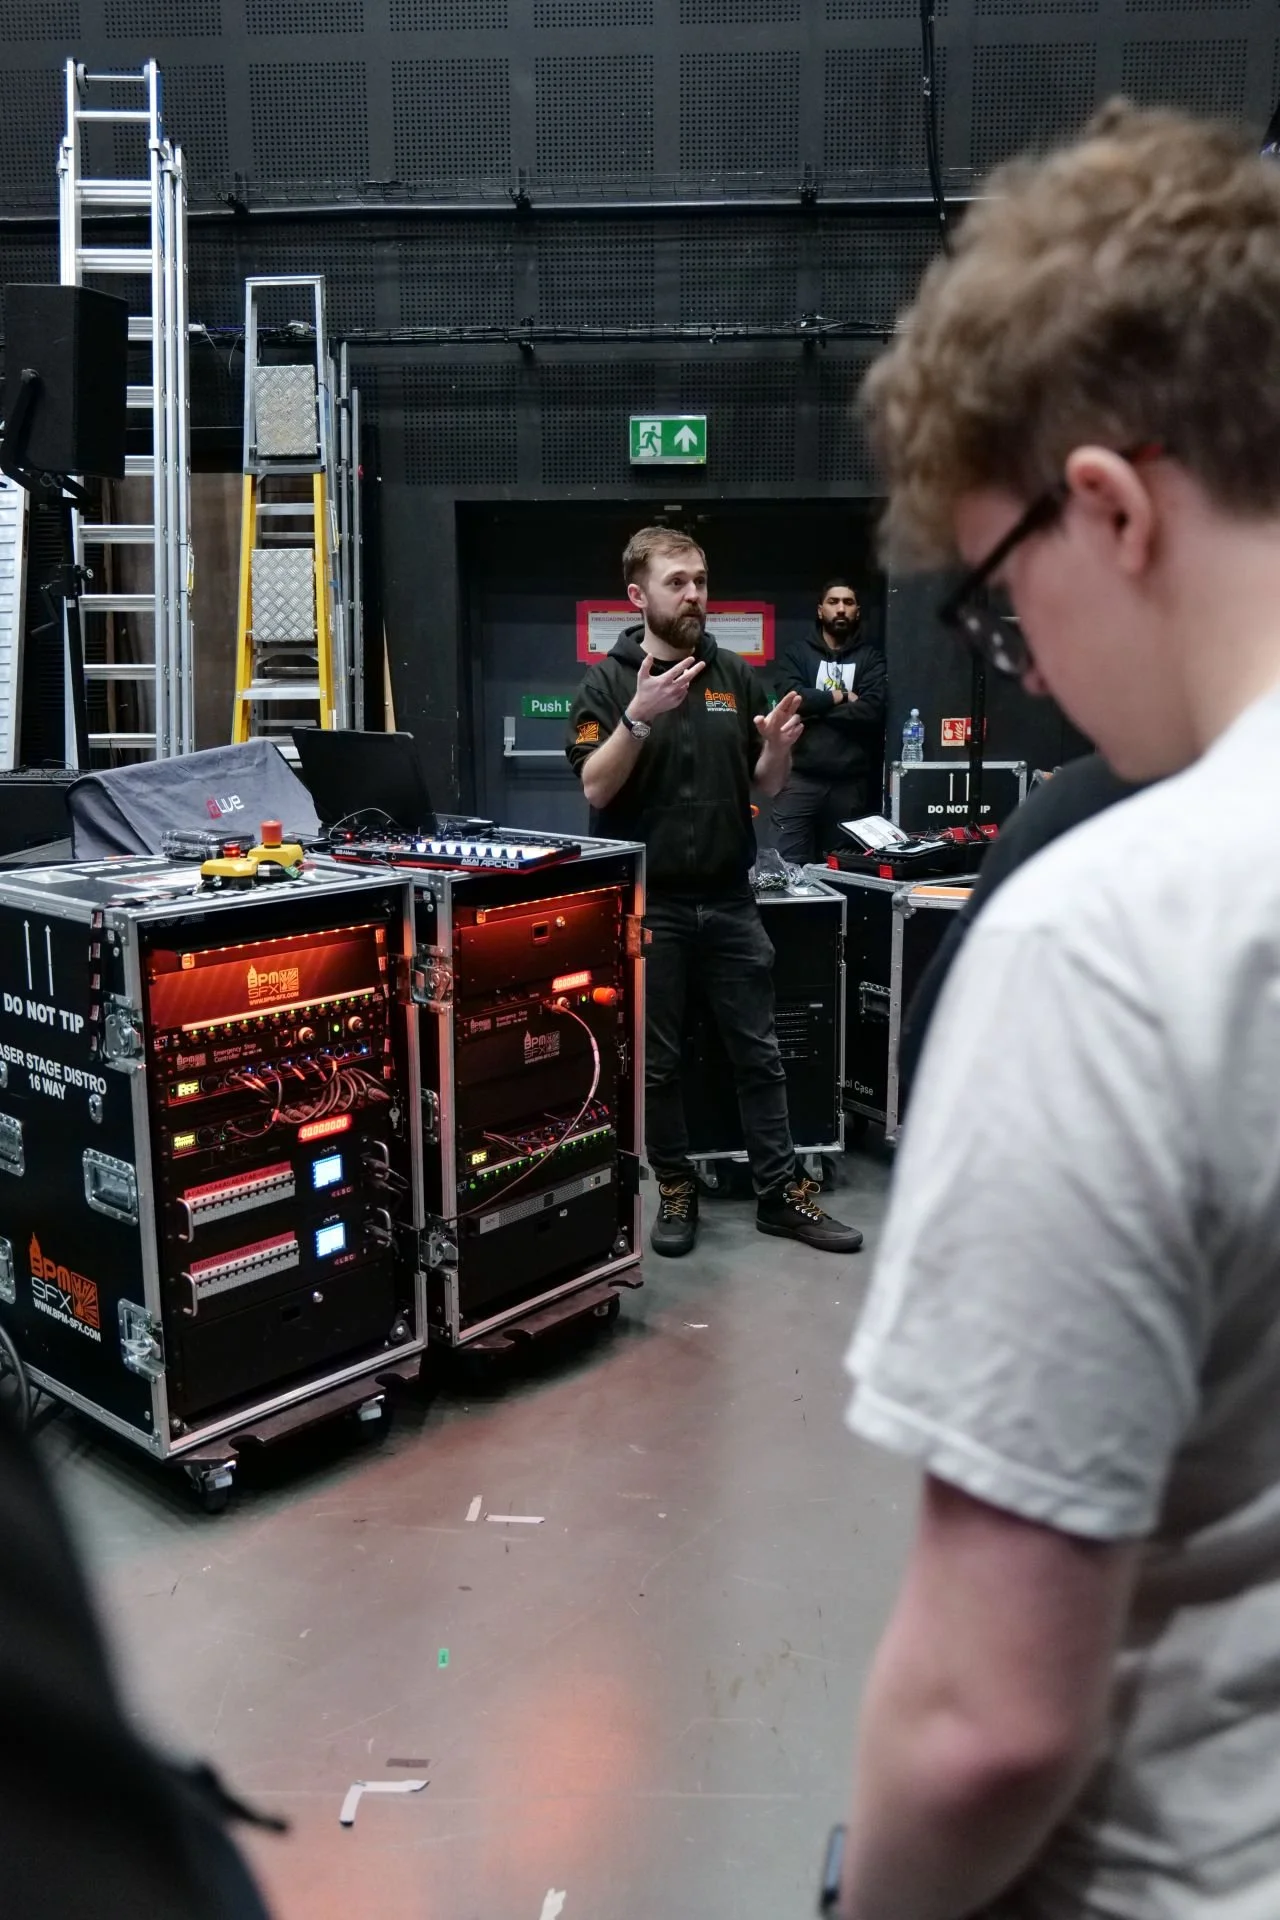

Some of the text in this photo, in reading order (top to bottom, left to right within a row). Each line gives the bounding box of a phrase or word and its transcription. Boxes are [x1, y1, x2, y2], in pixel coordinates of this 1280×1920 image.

[531, 699, 562, 713] Push
[927, 804, 943, 814] DO
[946, 804, 969, 814] NOT
[247, 964, 279, 989] BPM
[248, 983, 279, 999] SFX
[3, 992, 84, 1034] DO NOT TIP
[524, 1030, 546, 1050] BPM
[26, 1052, 62, 1080] STAGE
[63, 1065, 107, 1095] DISTRO
[28, 1073, 66, 1100] 16 WAY
[854, 1080, 874, 1096] Case
[29, 1232, 71, 1293] BPM
[31, 1276, 73, 1315] SFX
[33, 1297, 102, 1342] WWW.BPM-SFX.COM
